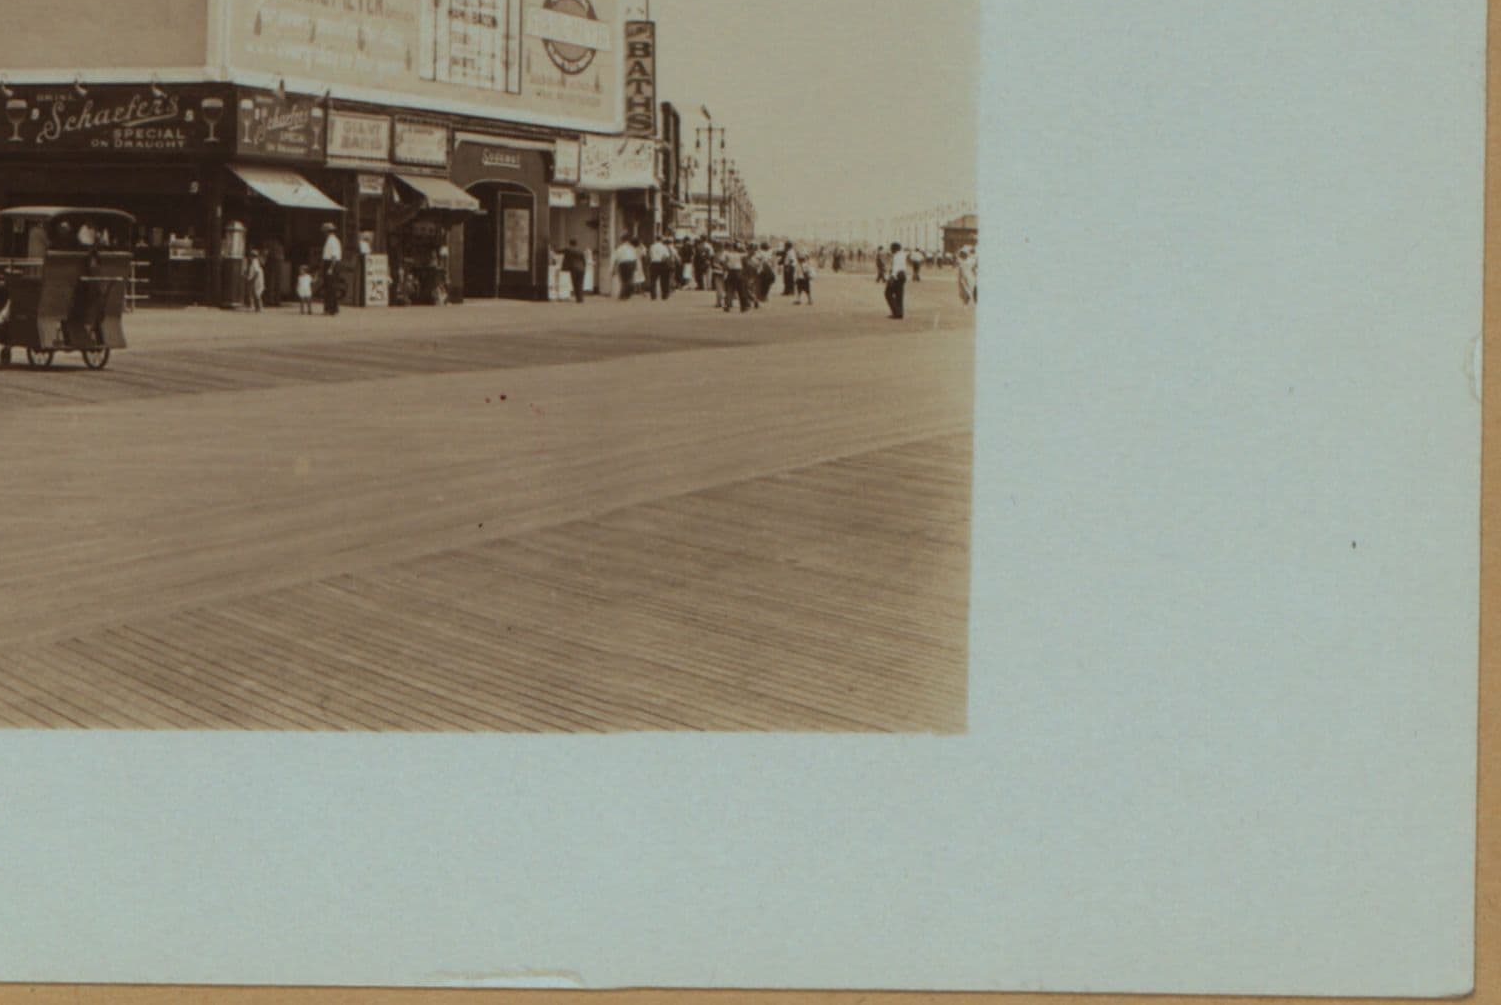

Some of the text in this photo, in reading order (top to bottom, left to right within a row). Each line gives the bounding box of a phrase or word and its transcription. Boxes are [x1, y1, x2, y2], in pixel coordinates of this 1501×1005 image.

[626, 41, 652, 131] BATHS
[113, 128, 186, 141] SPECIAL
[114, 139, 186, 149] DRAUGHT
